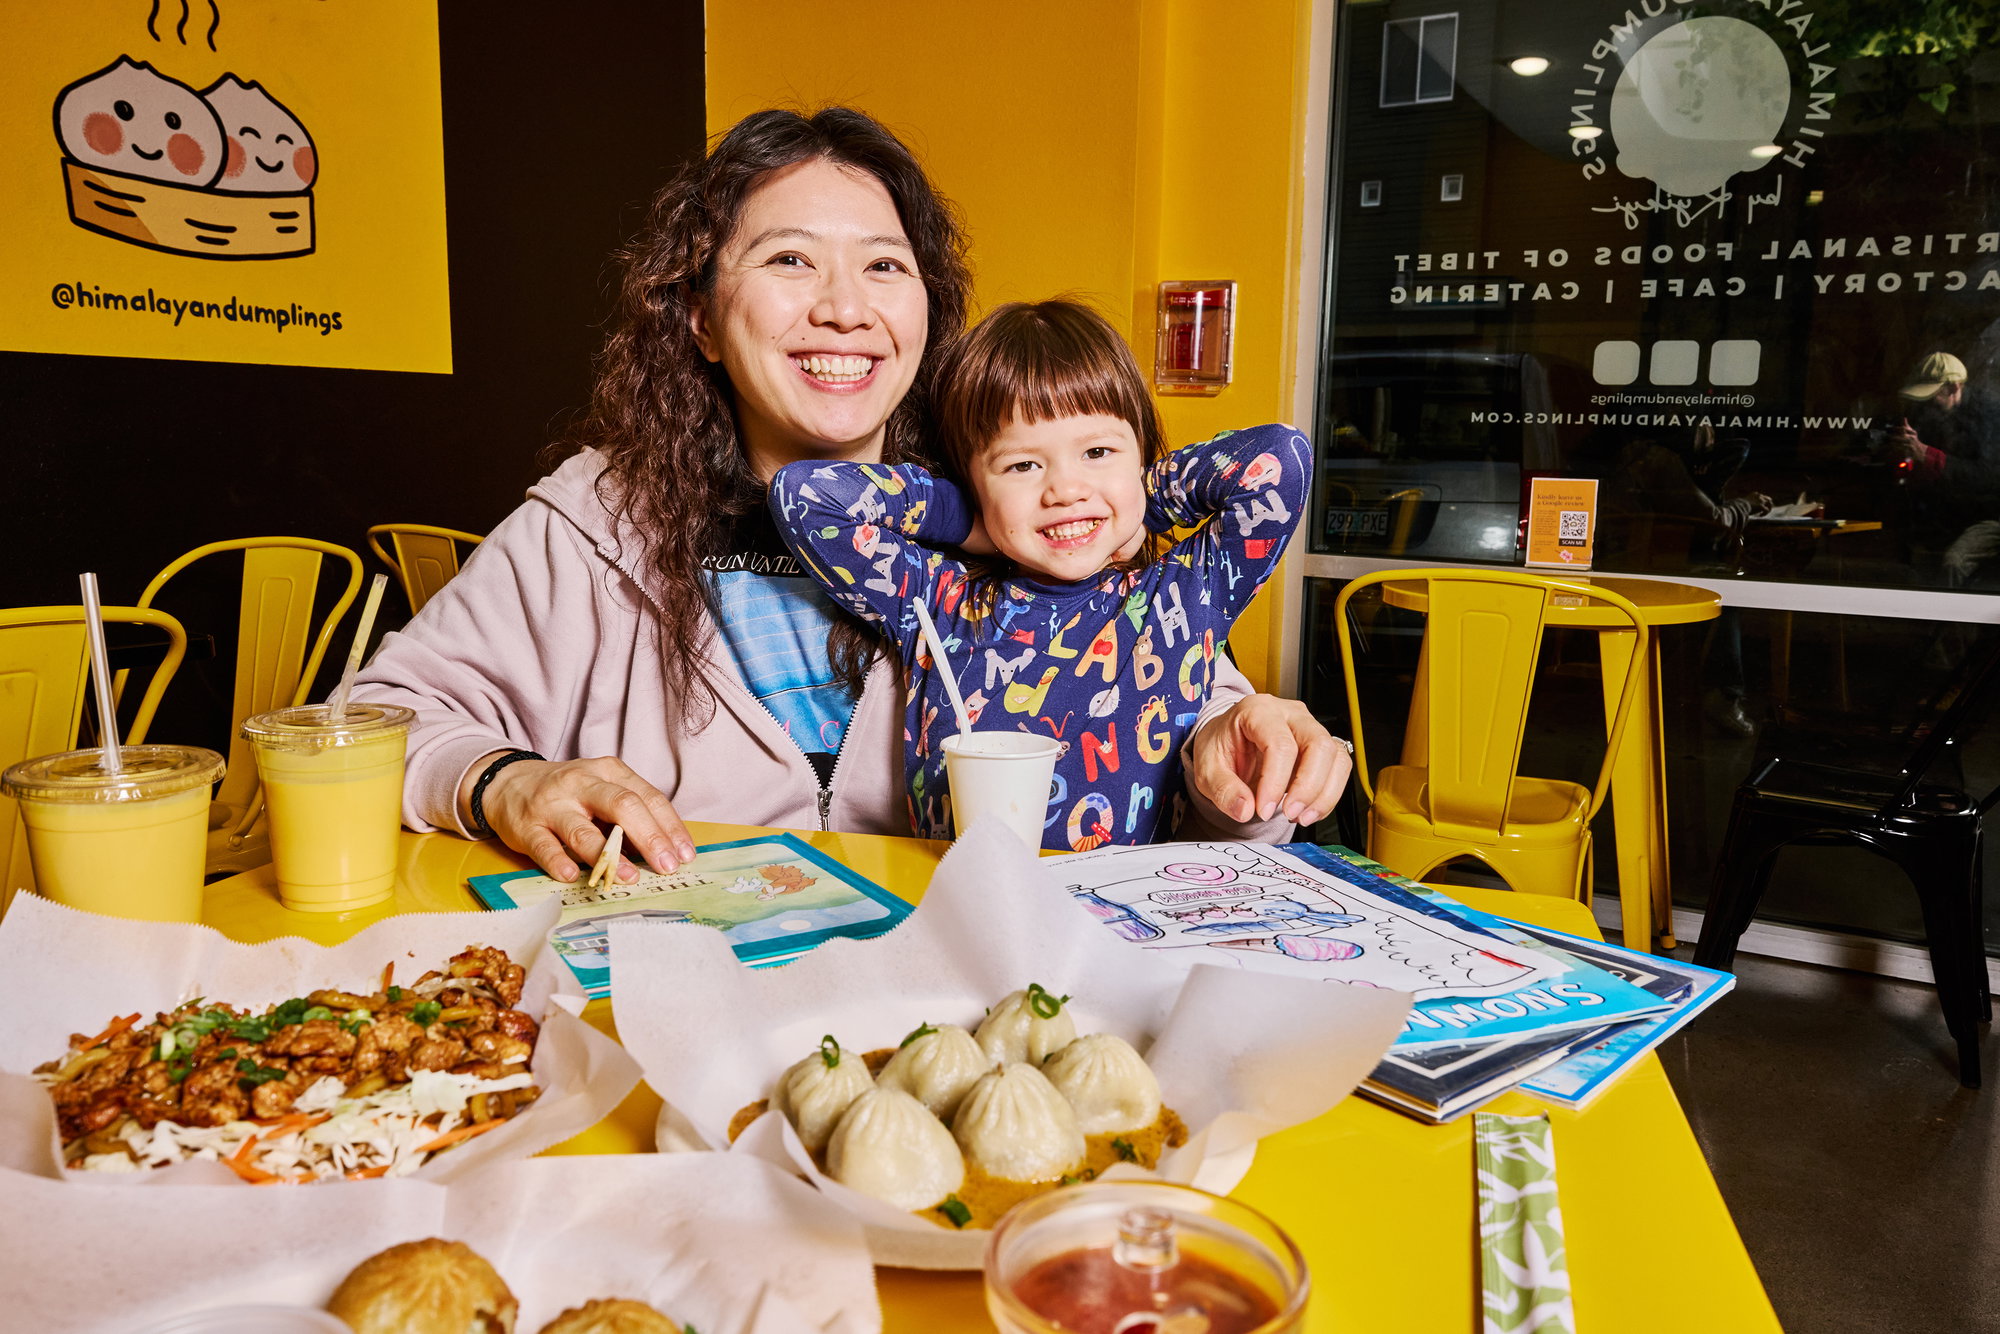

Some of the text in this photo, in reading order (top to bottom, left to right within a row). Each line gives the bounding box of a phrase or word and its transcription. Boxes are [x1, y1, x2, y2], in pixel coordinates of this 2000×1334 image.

[51, 281, 343, 336] @himalayandumplings
[701, 552, 749, 570] RUN
[646, 879, 714, 893] THE
